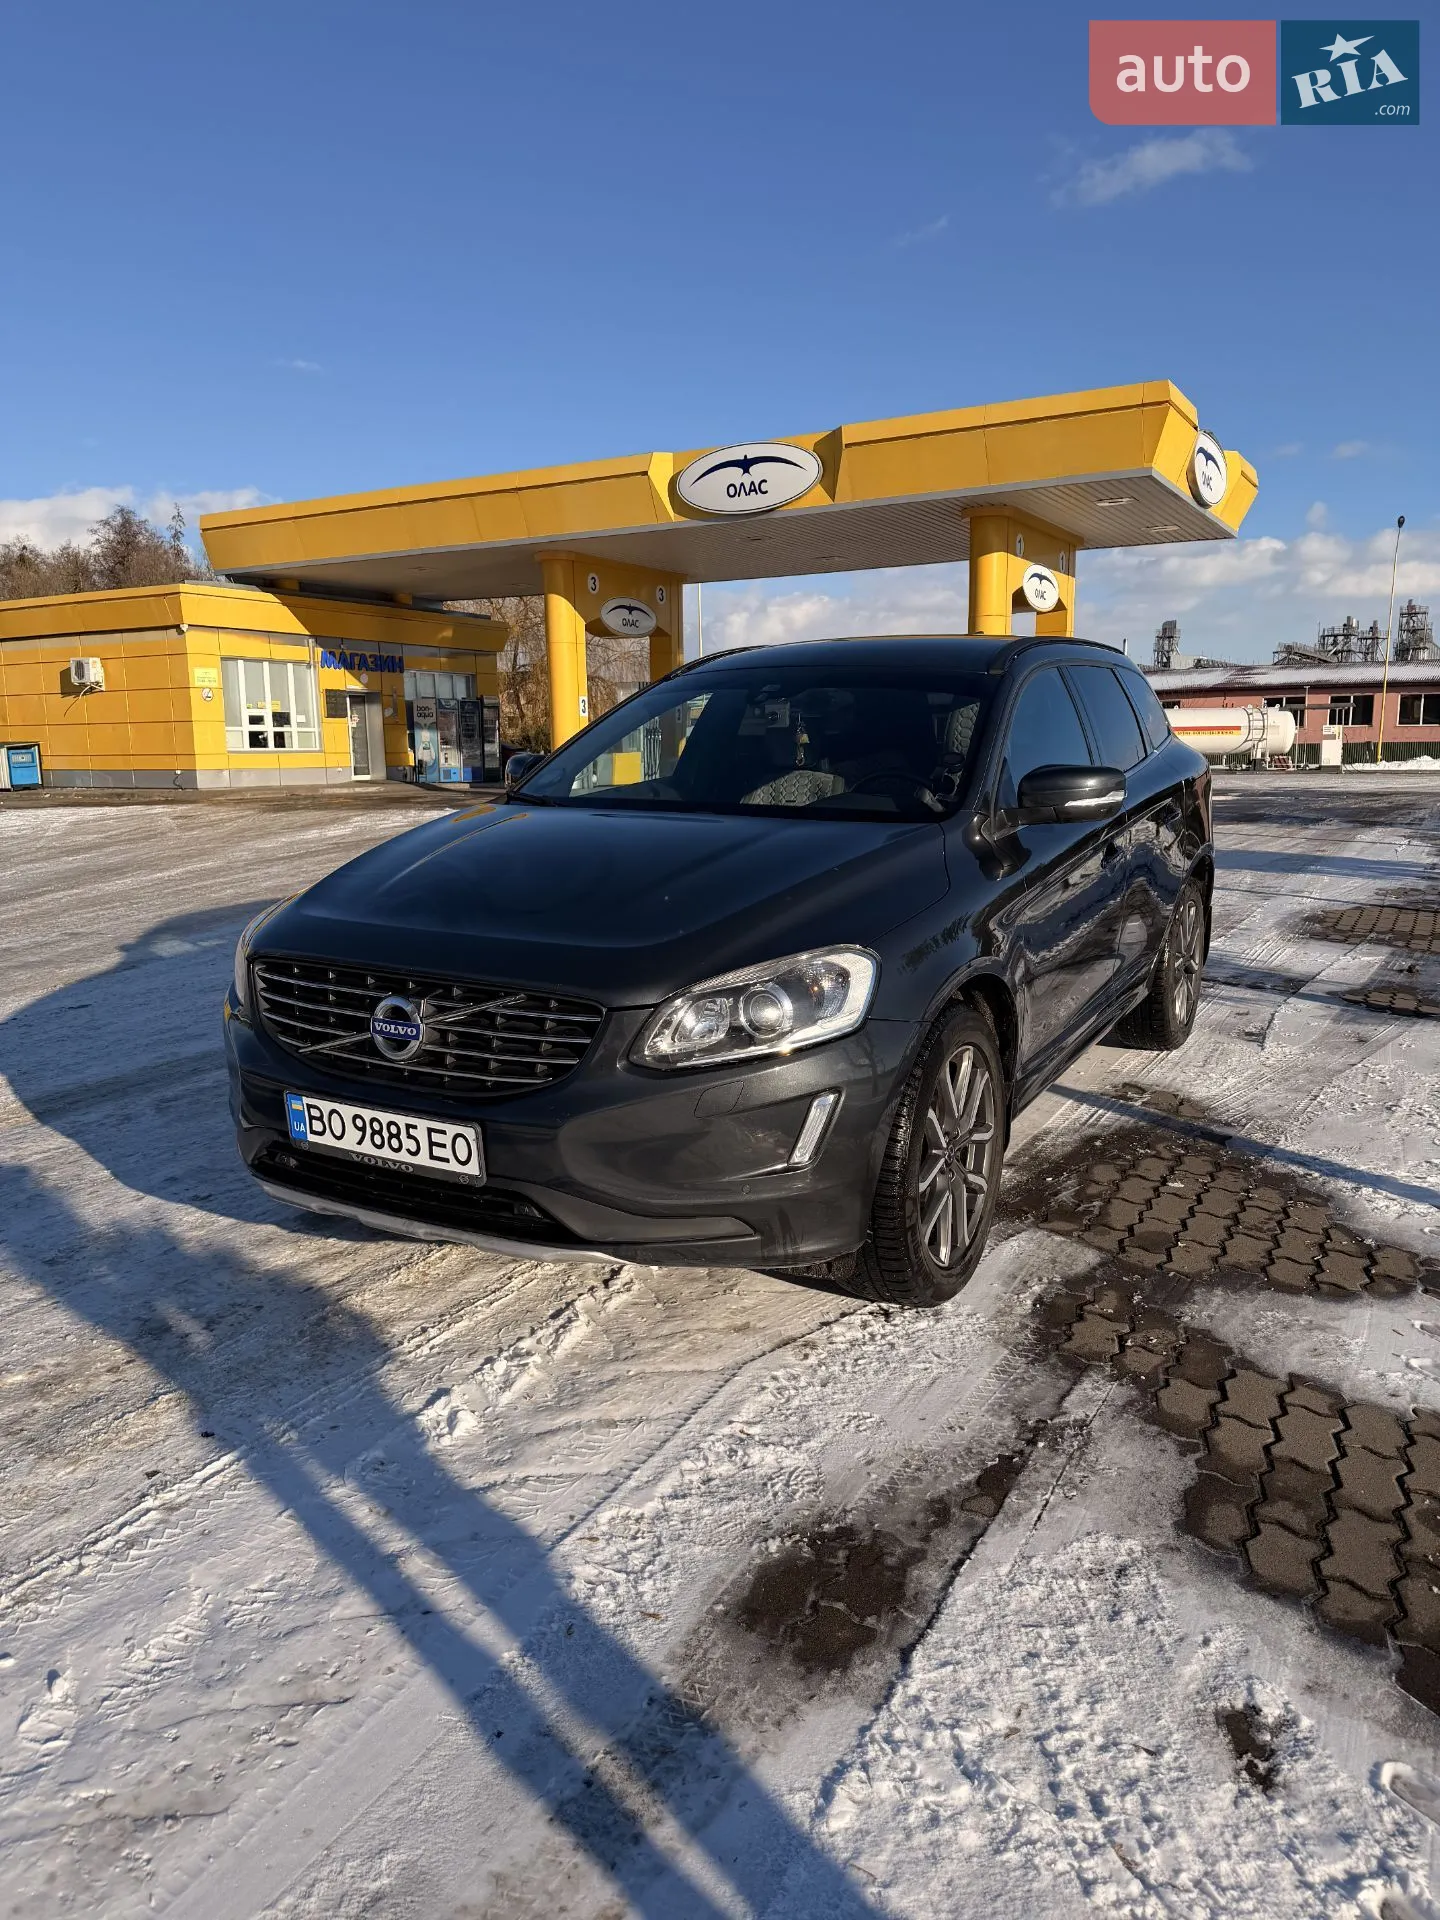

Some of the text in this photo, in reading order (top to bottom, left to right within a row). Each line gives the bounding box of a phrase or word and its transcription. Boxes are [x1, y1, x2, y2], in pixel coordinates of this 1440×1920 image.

[726, 479, 768, 498] ОЛАС
[590, 576, 597, 591] 3
[659, 587, 664, 601] 3
[622, 617, 640, 628] ОЛАС
[321, 649, 404, 673] МАГАЗИН
[581, 699, 586, 713] 3
[373, 1021, 417, 1036] VOLVO
[294, 1123, 306, 1132] UA
[305, 1102, 473, 1166] BO 9885 EO
[350, 1151, 414, 1173] VOLVO
